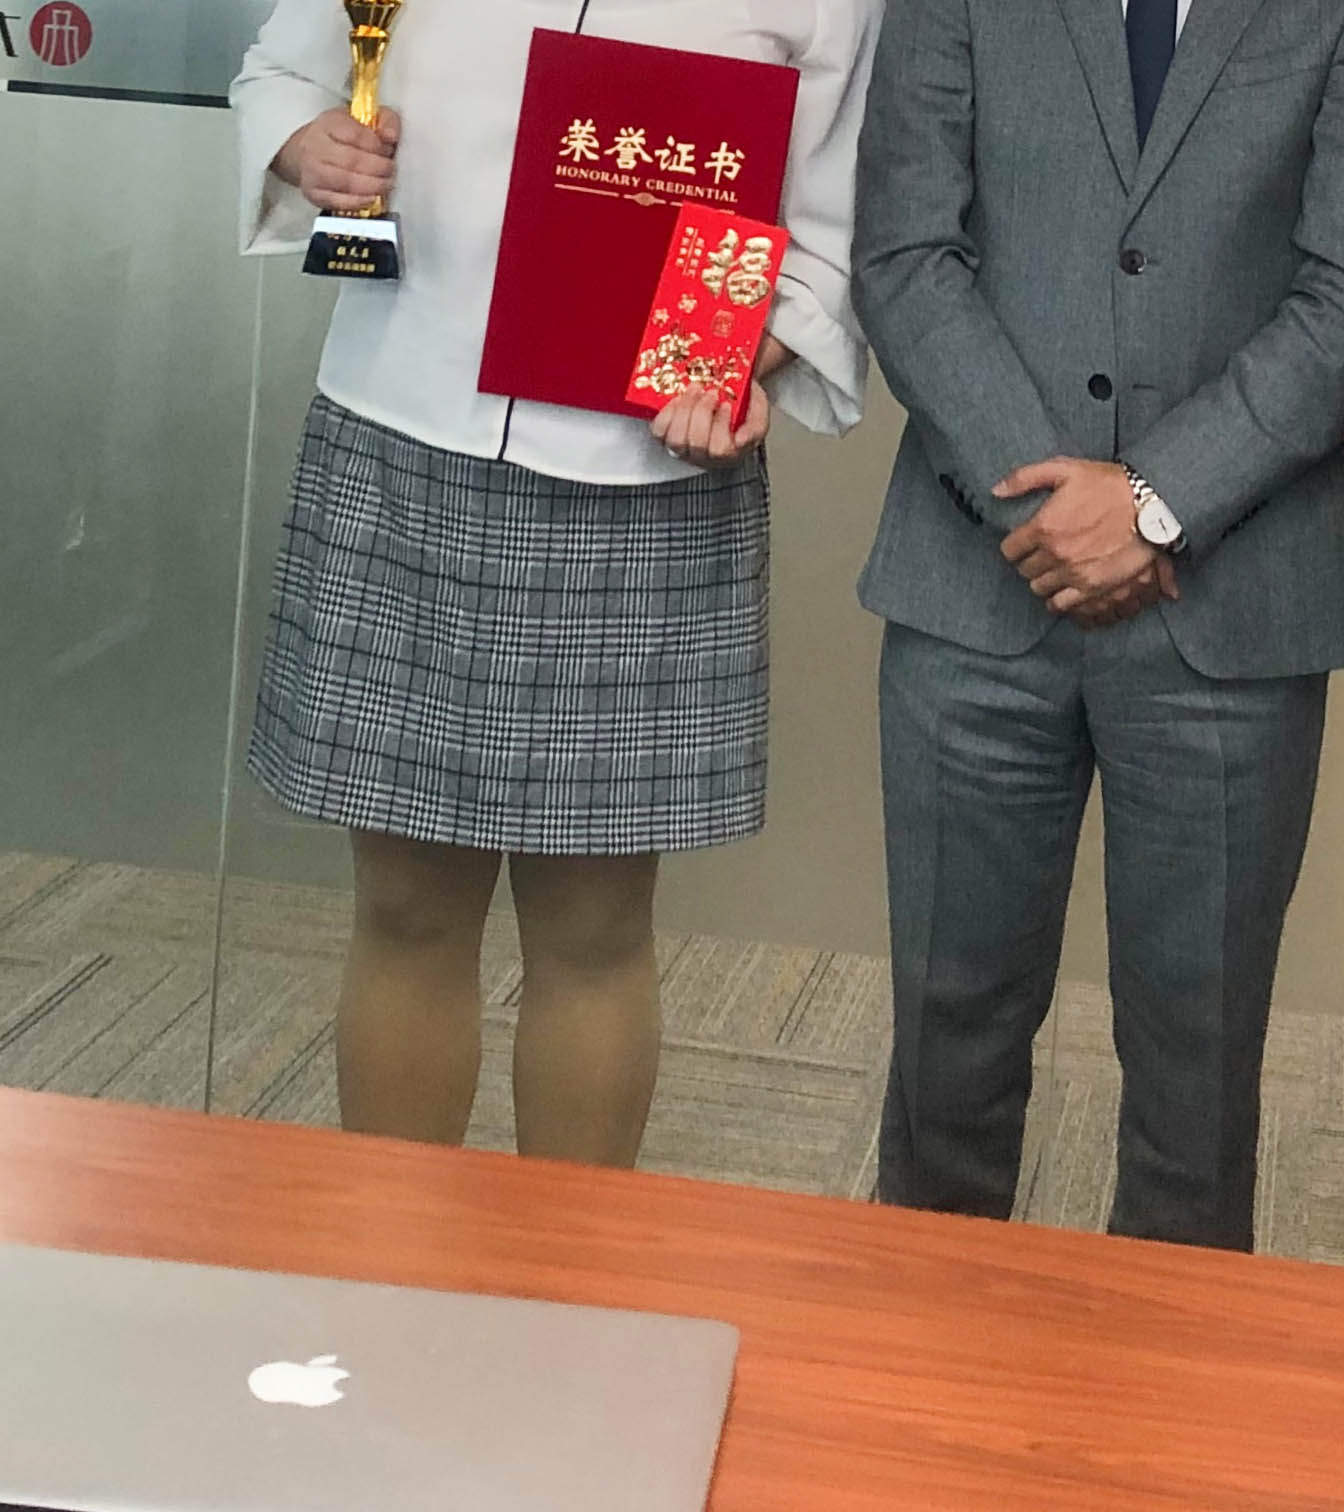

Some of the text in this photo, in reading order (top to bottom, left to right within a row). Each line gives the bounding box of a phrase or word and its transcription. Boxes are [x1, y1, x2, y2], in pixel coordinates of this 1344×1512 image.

[558, 118, 745, 185] 荣誉证书
[555, 164, 739, 204] HONORARY CREDENTIAL
